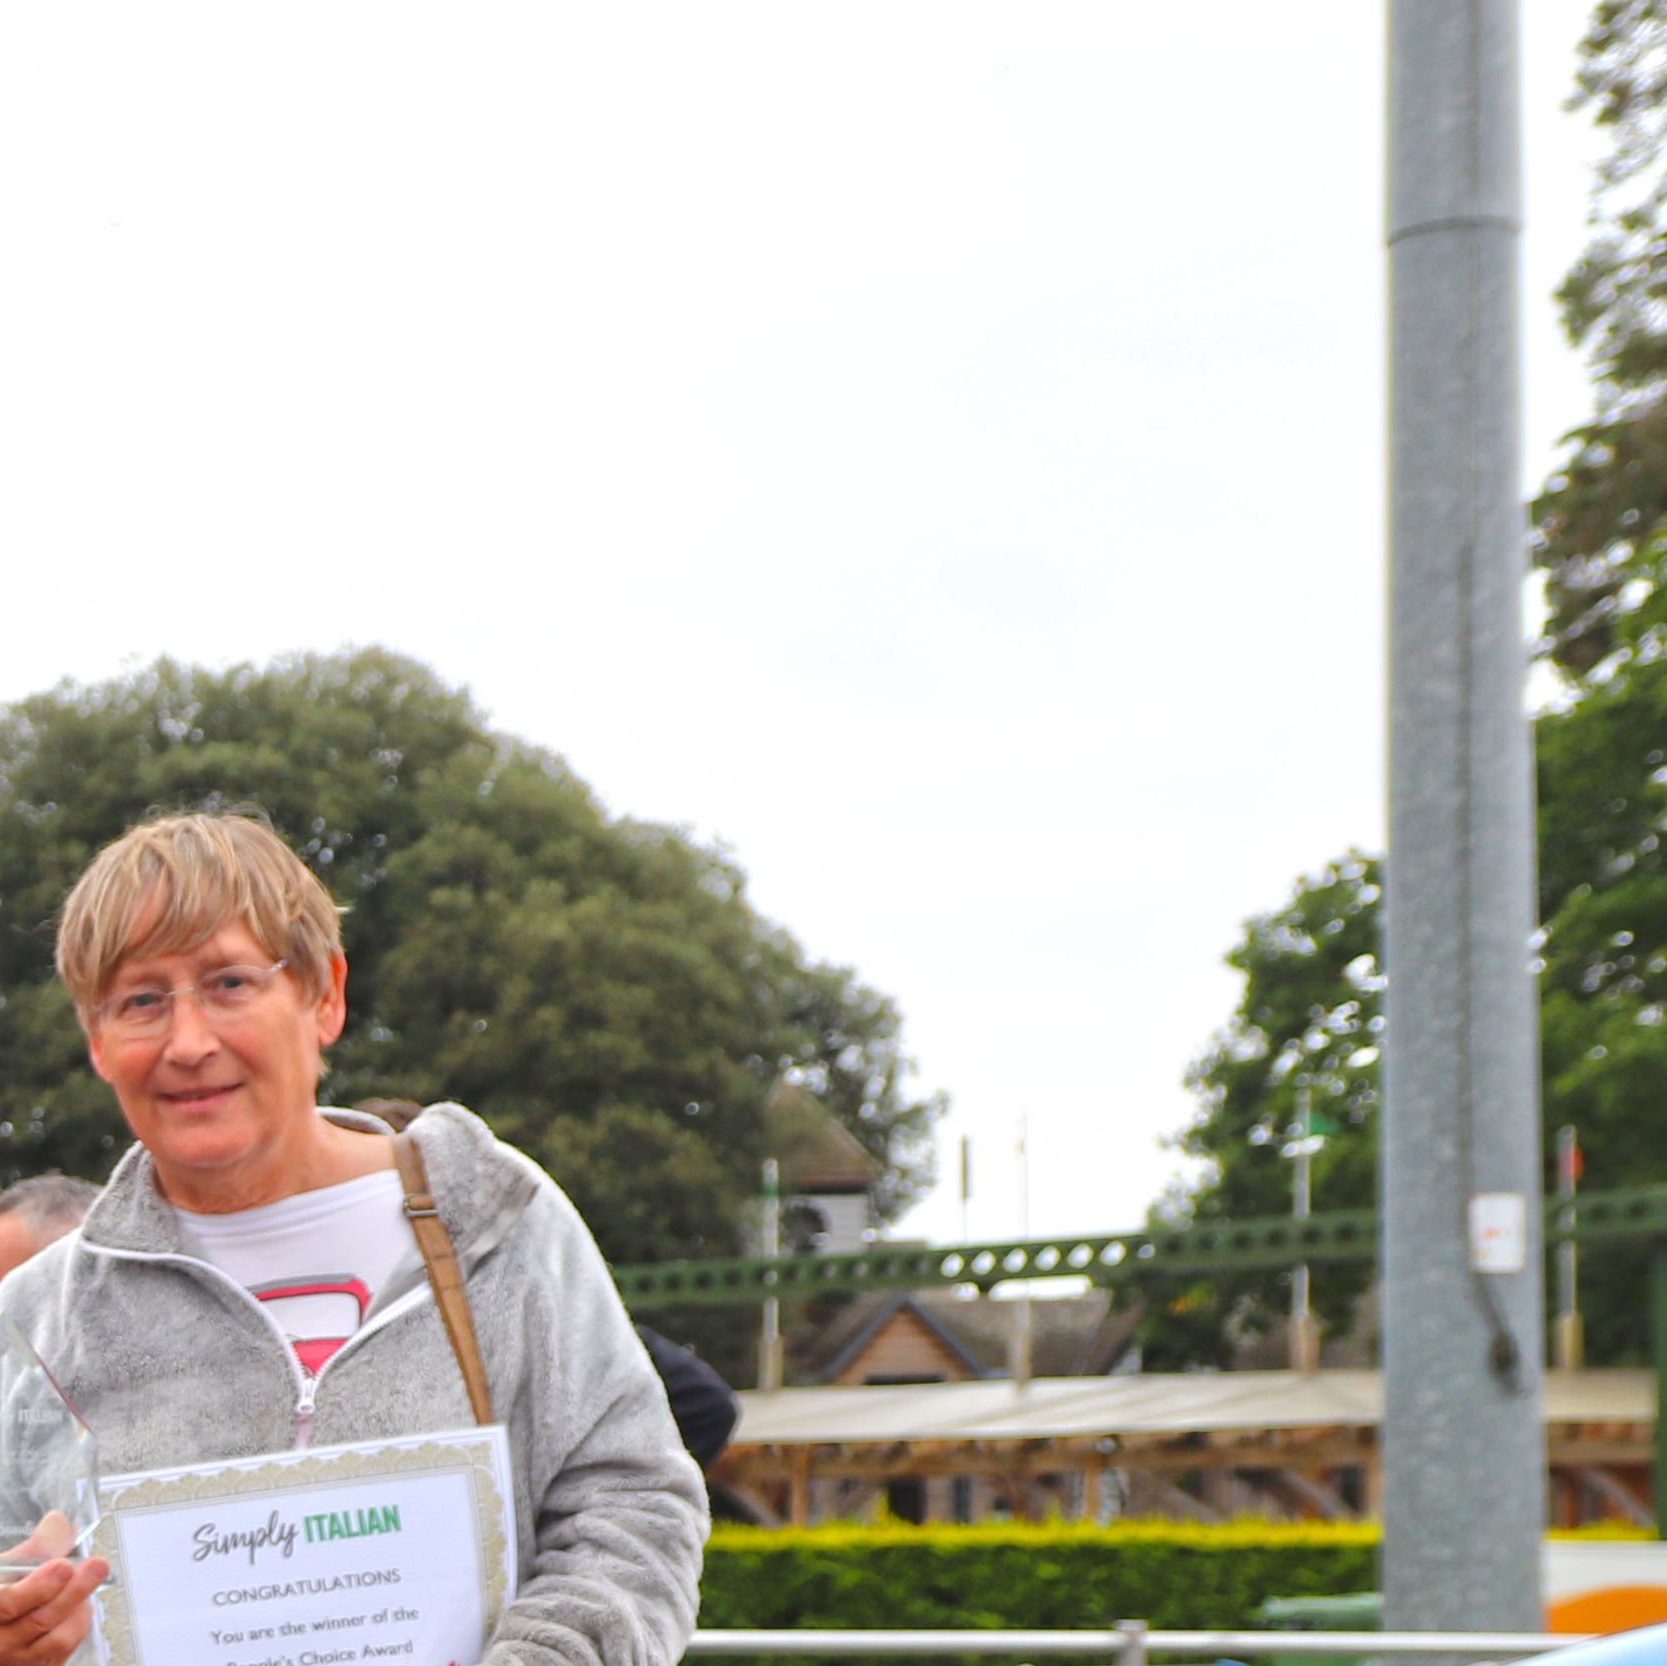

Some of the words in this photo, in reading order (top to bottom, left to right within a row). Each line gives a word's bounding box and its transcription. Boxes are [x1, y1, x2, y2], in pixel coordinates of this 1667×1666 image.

[192, 1509, 299, 1566] Simply
[303, 1504, 403, 1544] ITALIAN
[212, 1568, 402, 1607] CONGRATULATIONS
[211, 1630, 244, 1646] You
[250, 1627, 275, 1640] are
[280, 1621, 306, 1637] the
[312, 1614, 366, 1632] winner
[372, 1608, 389, 1624] of
[394, 1606, 419, 1621] the
[300, 1648, 357, 1666] Choice
[362, 1640, 414, 1659] Award
